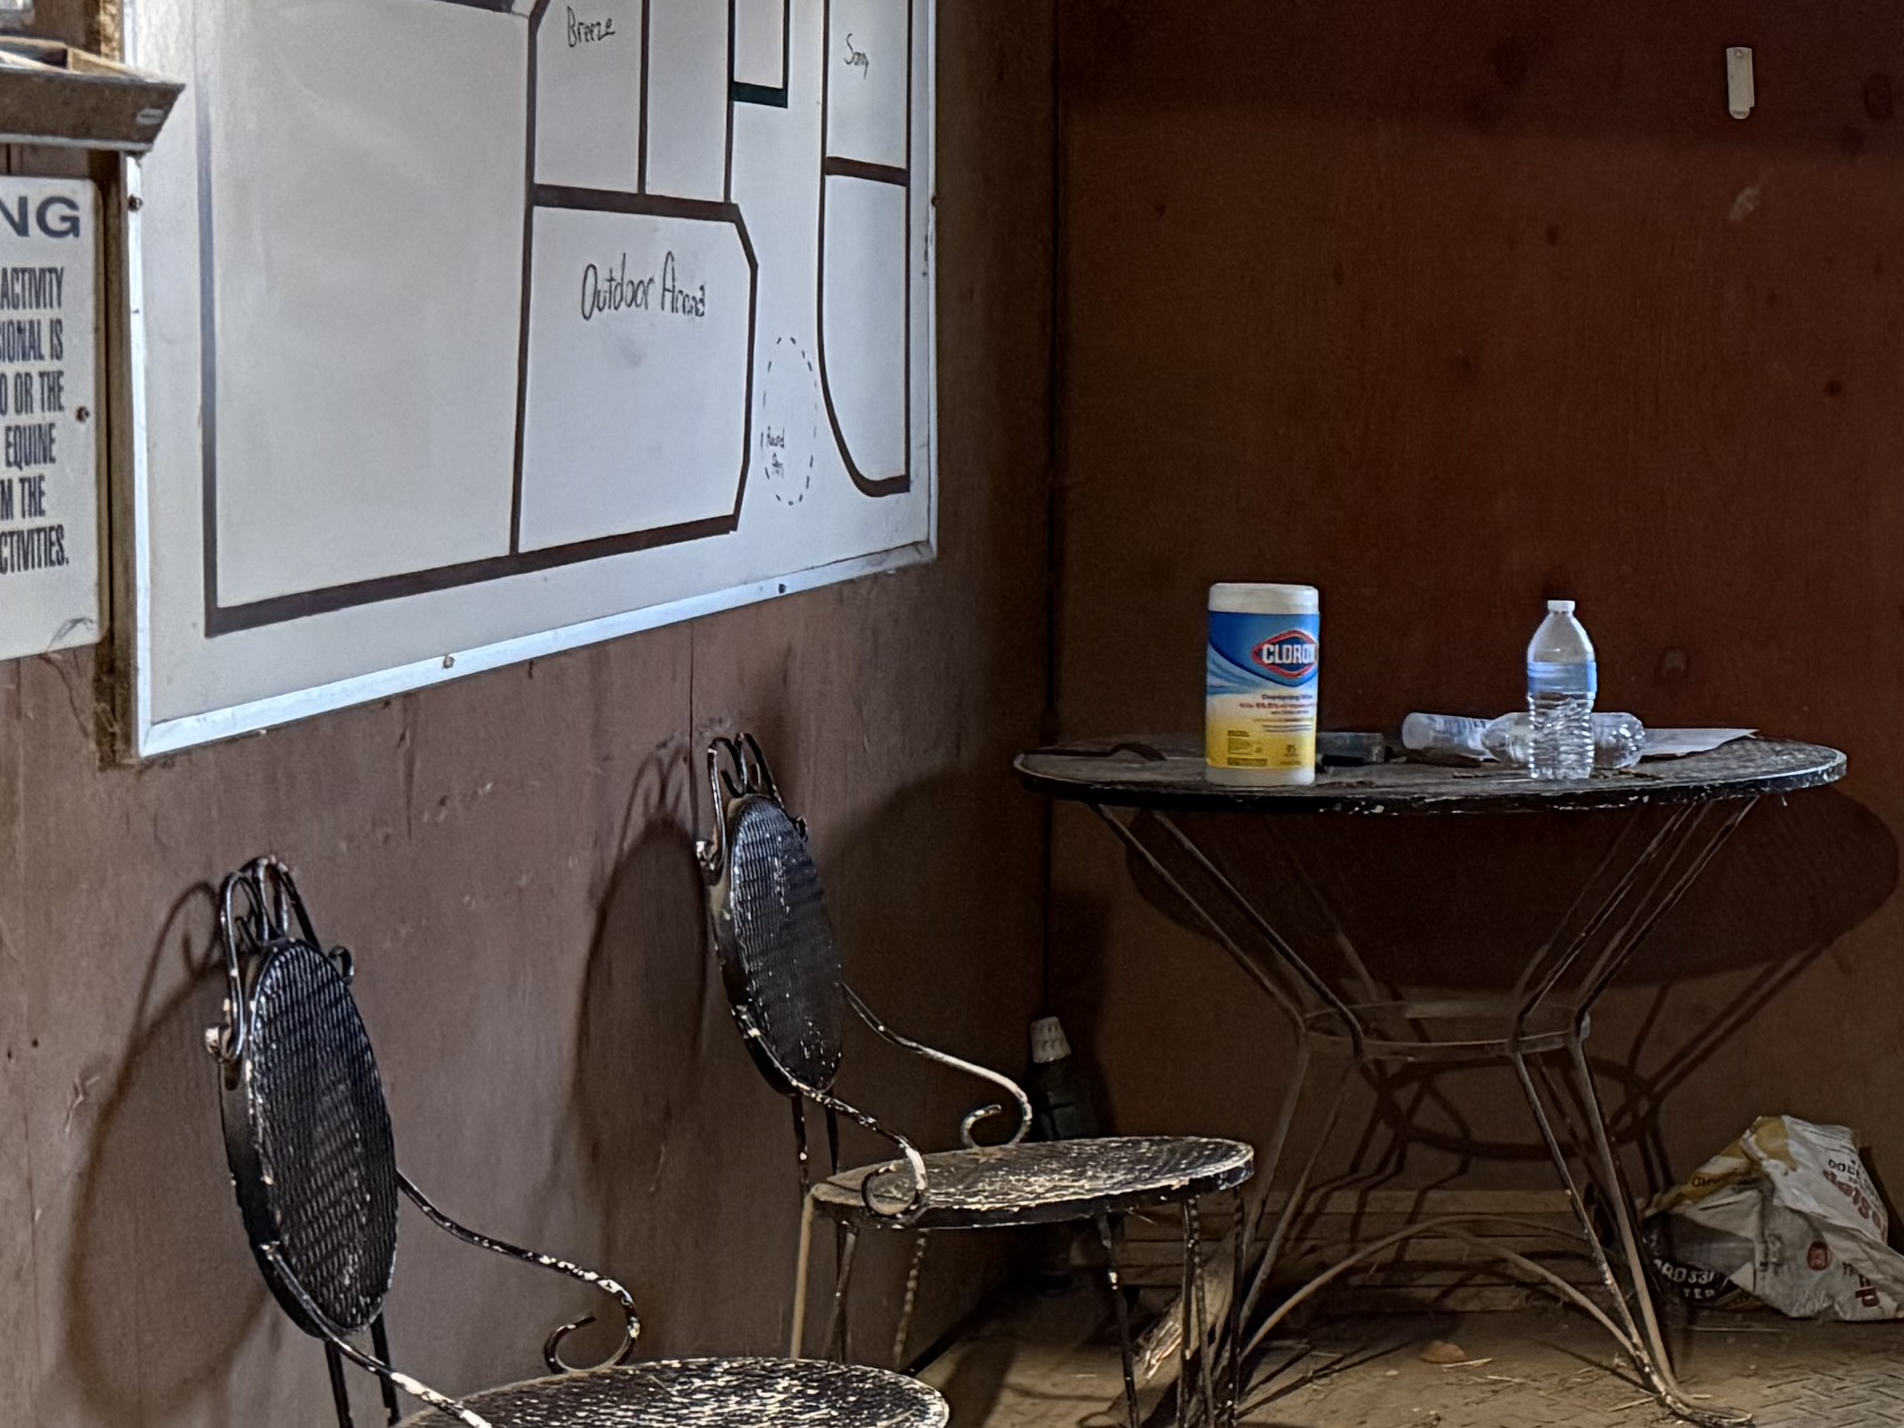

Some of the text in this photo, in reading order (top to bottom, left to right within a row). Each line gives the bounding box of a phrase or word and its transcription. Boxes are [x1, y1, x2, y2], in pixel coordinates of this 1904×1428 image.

[567, 5, 616, 48] Breeze
[0, 266, 65, 311] ACTIVITY
[581, 250, 705, 321] Outdoor Arena
[50, 318, 63, 361] IS
[14, 371, 34, 415] OR
[39, 369, 65, 413] THE
[5, 422, 57, 471] EQUINE
[19, 474, 46, 519] THE
